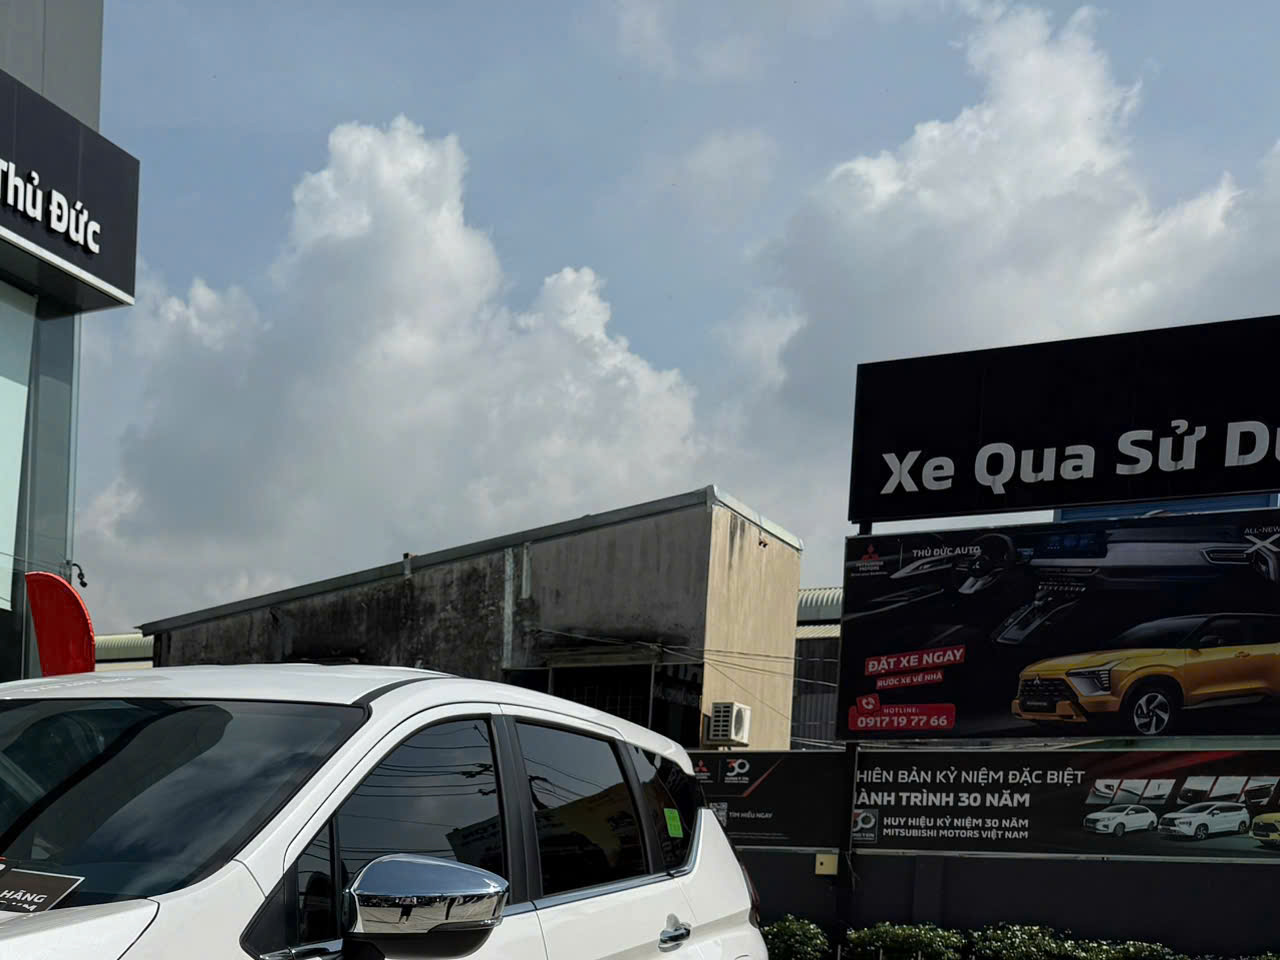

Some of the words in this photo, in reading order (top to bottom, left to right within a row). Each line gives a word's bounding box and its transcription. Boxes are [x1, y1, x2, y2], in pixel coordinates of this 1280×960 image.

[49, 189, 100, 254] Đức
[880, 450, 955, 495] Xe
[974, 442, 1096, 495] Qua
[1116, 419, 1207, 476] Sử
[1224, 420, 1280, 467] D
[912, 547, 932, 558] THỦ
[933, 545, 953, 557] ĐỨC
[954, 546, 981, 555] AUTO
[868, 656, 897, 673] ĐẶT
[900, 655, 918, 668] XE
[923, 648, 964, 665] NGAY
[857, 716, 889, 728] 0917
[891, 716, 907, 727] 19
[911, 716, 928, 727] 77
[930, 715, 948, 727] 66
[898, 766, 931, 783] BẢN
[936, 766, 957, 783] KỶ
[961, 767, 1003, 786] NIỆM
[1008, 767, 1042, 786] ĐẶC
[1047, 767, 1086, 786] BIỆT
[899, 788, 954, 807] TRÌNH
[958, 792, 981, 807] 30
[985, 789, 1030, 807] NĂM
[883, 816, 906, 827] HUY
[908, 816, 934, 828] HIỆU
[936, 815, 951, 827] KỶ
[953, 816, 982, 829] NIỆM
[984, 818, 999, 828] 30
[1001, 817, 1029, 828] NĂM
[882, 828, 937, 838] MITSUBISHI
[938, 829, 979, 839] MOTORS
[981, 829, 1002, 840] VIỆT
[1002, 830, 1029, 839] NAM
[2, 889, 47, 904] HÃNG
